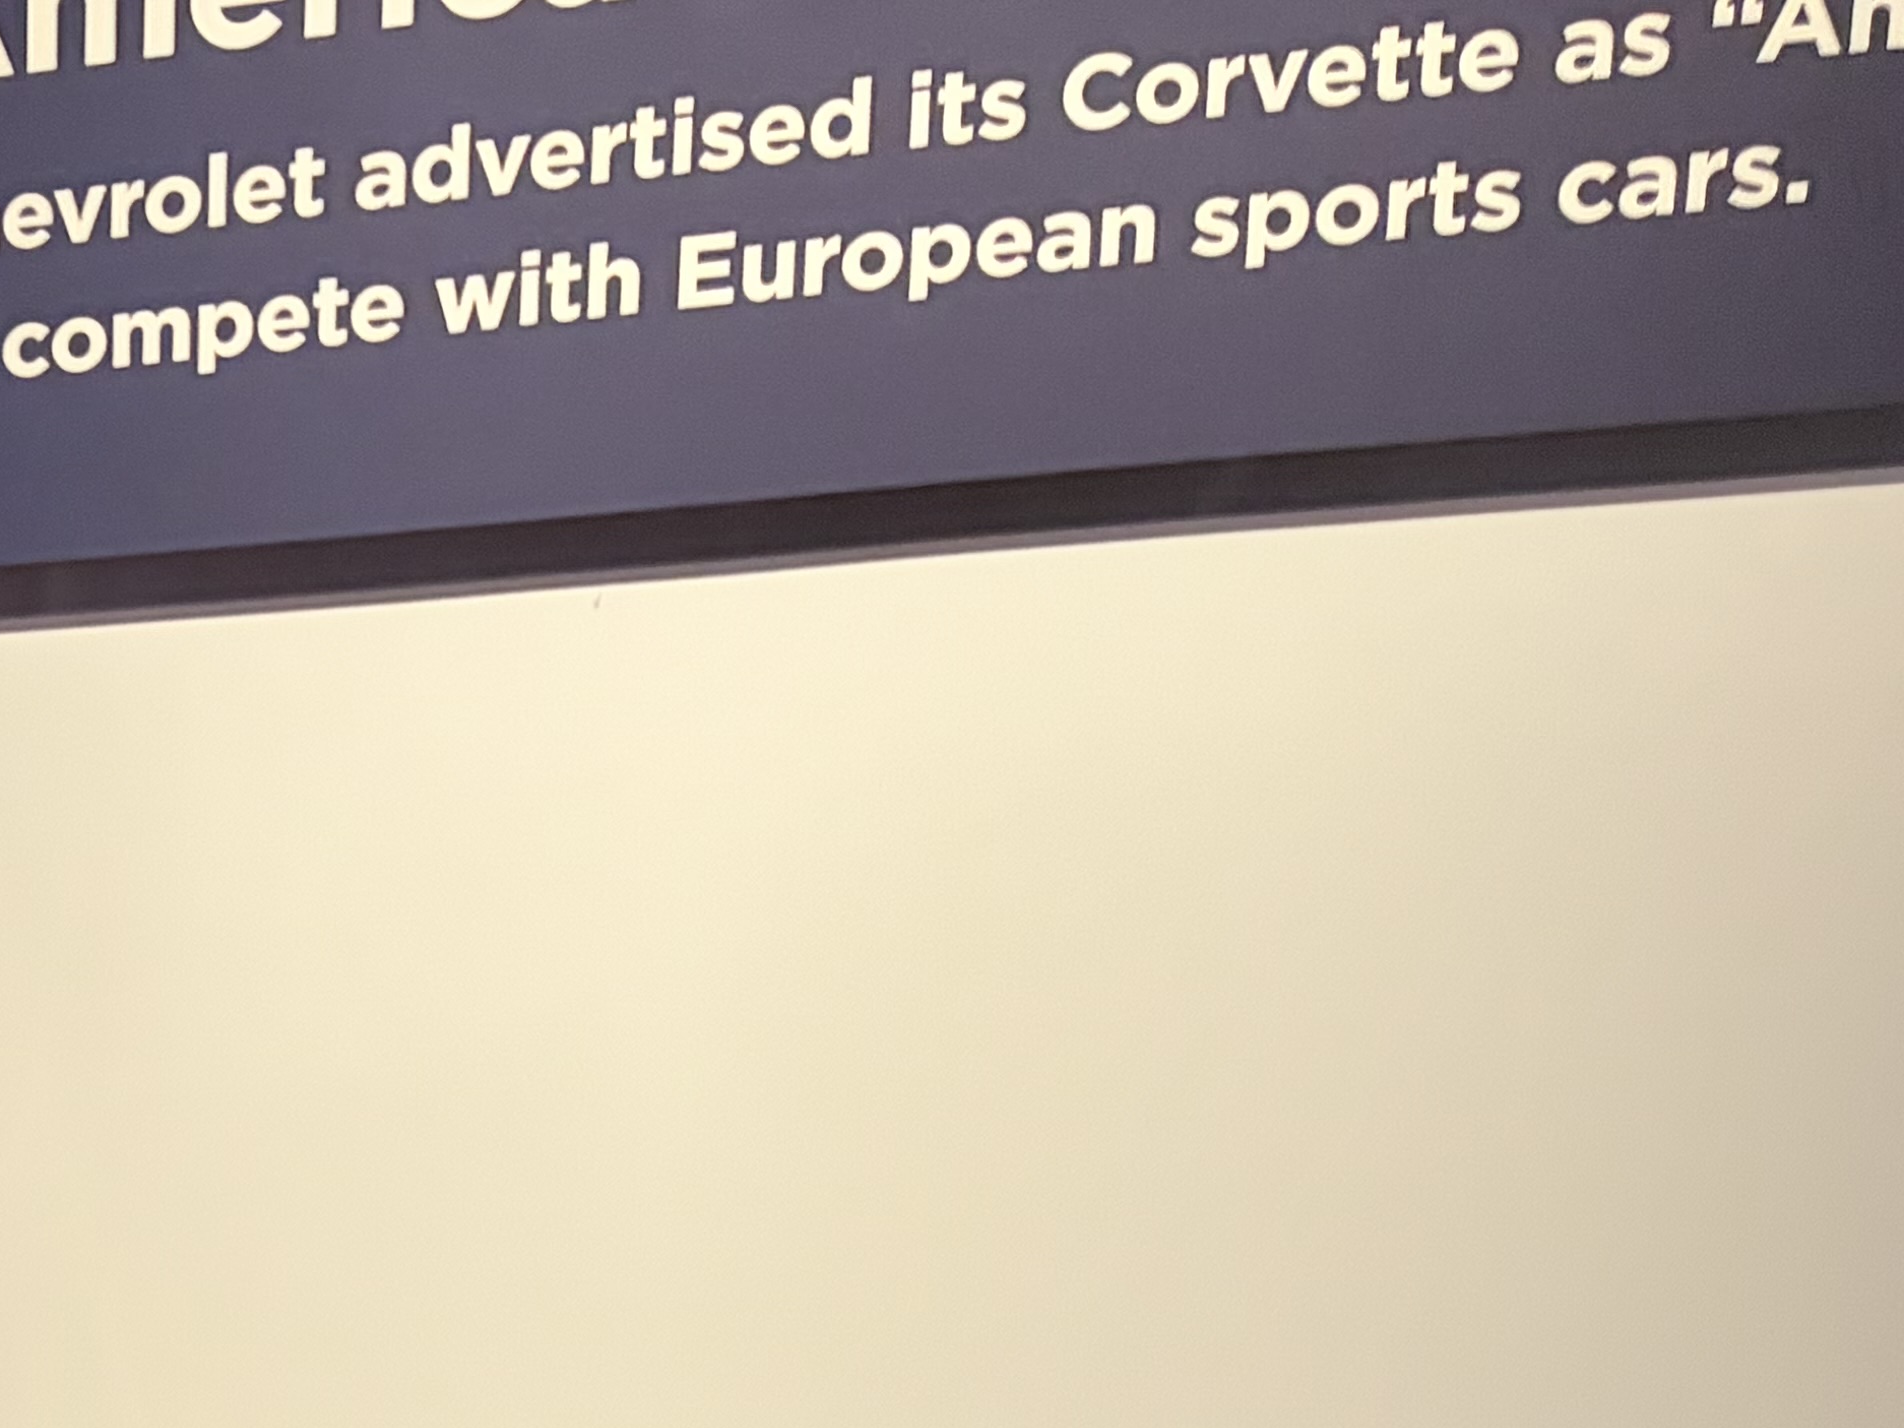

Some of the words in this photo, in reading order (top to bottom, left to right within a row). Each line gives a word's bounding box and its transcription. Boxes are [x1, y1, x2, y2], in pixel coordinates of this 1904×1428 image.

[354, 75, 873, 211] advertised
[908, 68, 1026, 150] its
[1062, 20, 1519, 131] Corvette
[1555, 12, 1671, 84] as
[2, 277, 405, 375] compete
[434, 241, 641, 335] with
[677, 204, 1156, 310] European
[1190, 160, 1521, 270] sports
[1558, 145, 1809, 224] cars.
